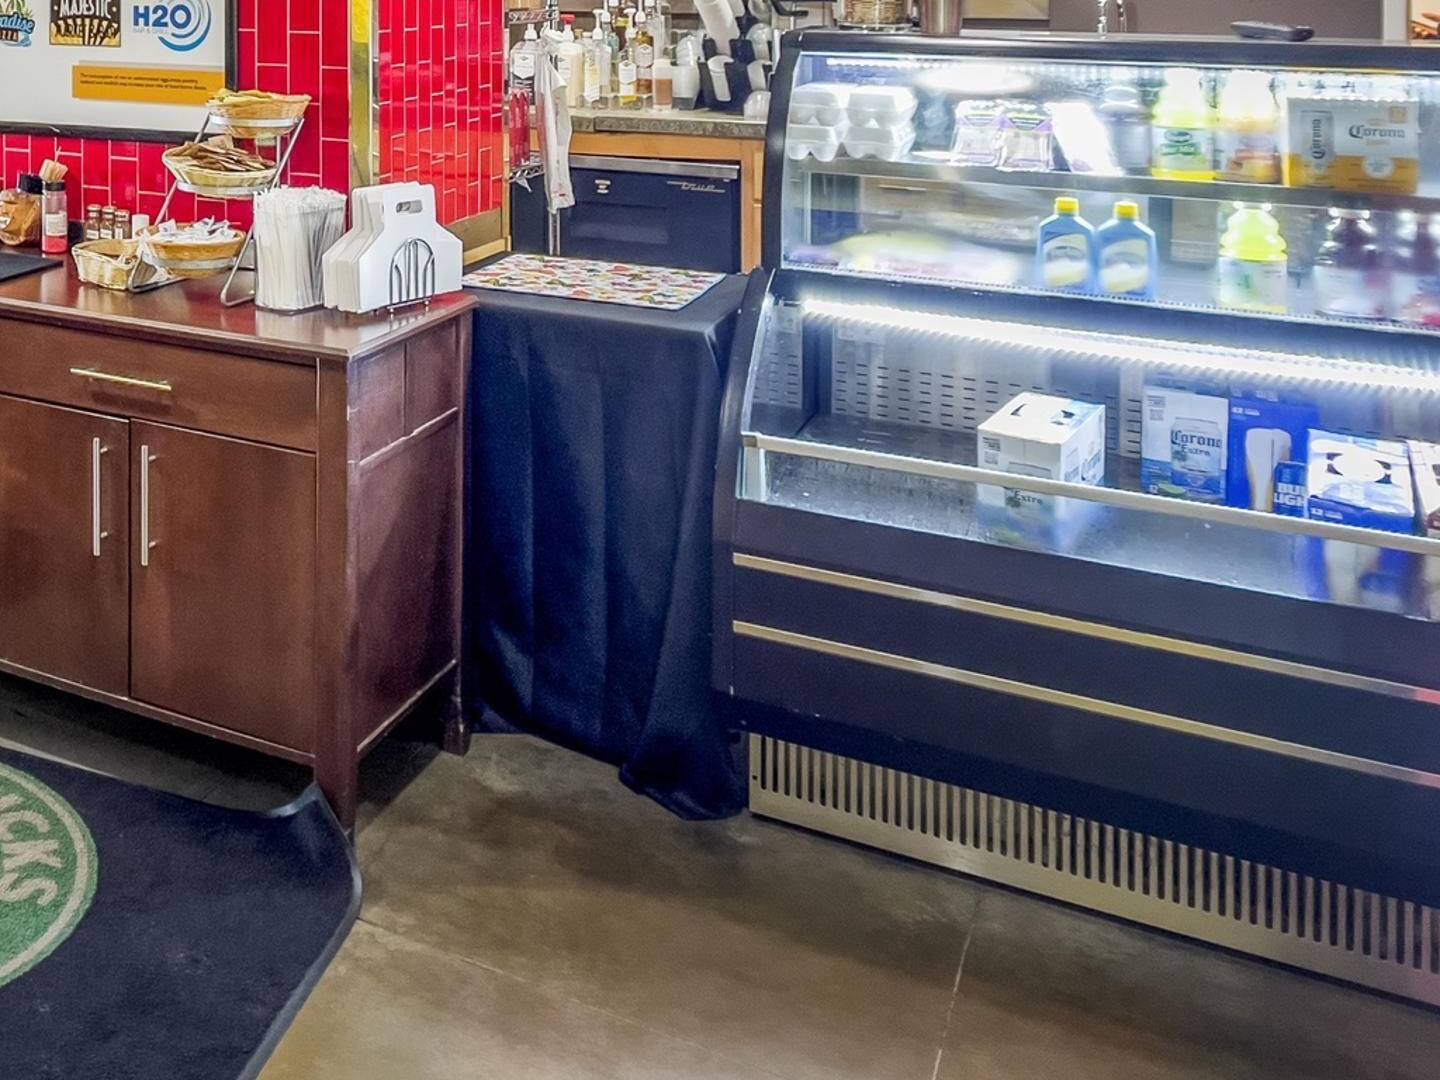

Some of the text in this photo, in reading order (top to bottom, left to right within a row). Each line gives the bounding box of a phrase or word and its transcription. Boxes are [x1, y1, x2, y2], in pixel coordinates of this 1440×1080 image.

[134, 4, 191, 29] H2O
[1348, 124, 1405, 139] Corona
[1171, 429, 1222, 449] Corona
